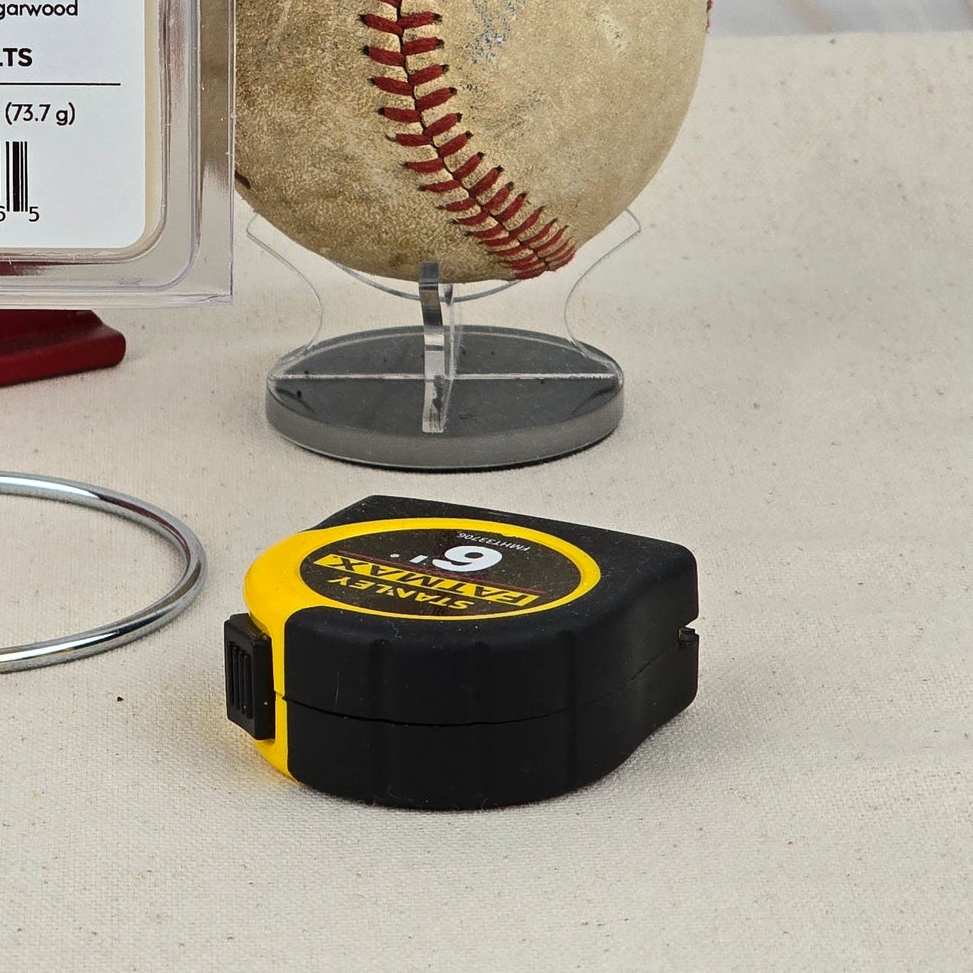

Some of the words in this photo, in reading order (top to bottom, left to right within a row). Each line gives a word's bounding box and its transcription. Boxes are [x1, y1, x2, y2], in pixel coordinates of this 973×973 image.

[6, 102, 50, 125] (73.7
[56, 102, 75, 126] g)
[28, 207, 39, 222] 5
[328, 576, 475, 610] STANLEY
[329, 555, 531, 605] FATMAX
